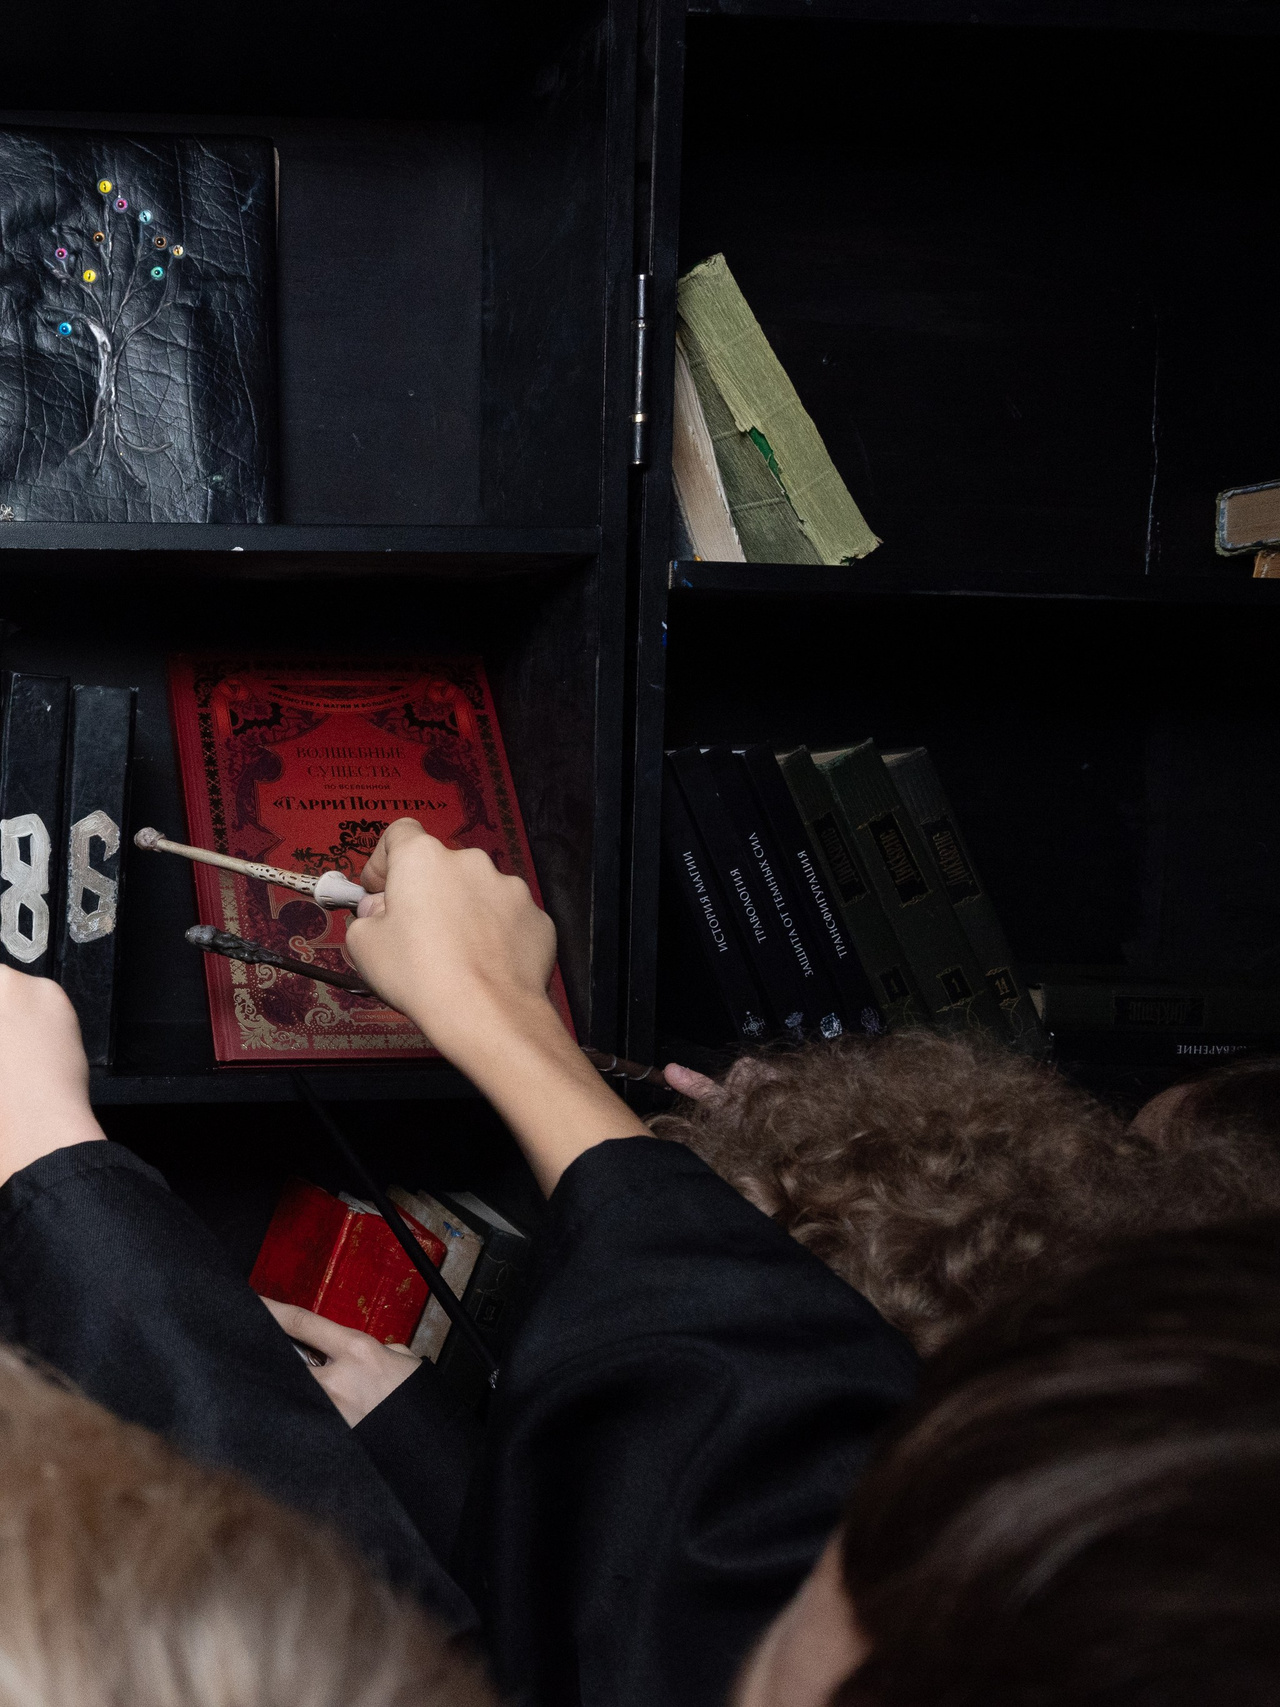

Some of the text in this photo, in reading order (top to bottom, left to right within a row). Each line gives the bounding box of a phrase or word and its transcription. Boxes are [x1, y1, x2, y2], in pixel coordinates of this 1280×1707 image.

[296, 746, 407, 759] ВОЛШЕБНЫЕ
[307, 765, 402, 778] СУЩЕСТВА
[67, 809, 121, 944] 6
[682, 850, 728, 953] ИСТОРИЯ МАГИИ
[729, 868, 767, 944] ТРАВОЛОГИЯ
[748, 831, 814, 978] ЗАЩИТА ОТ ТЕМНЫХ СИЛ
[797, 850, 848, 959] ТРАНСФИГУРАЦИЯ
